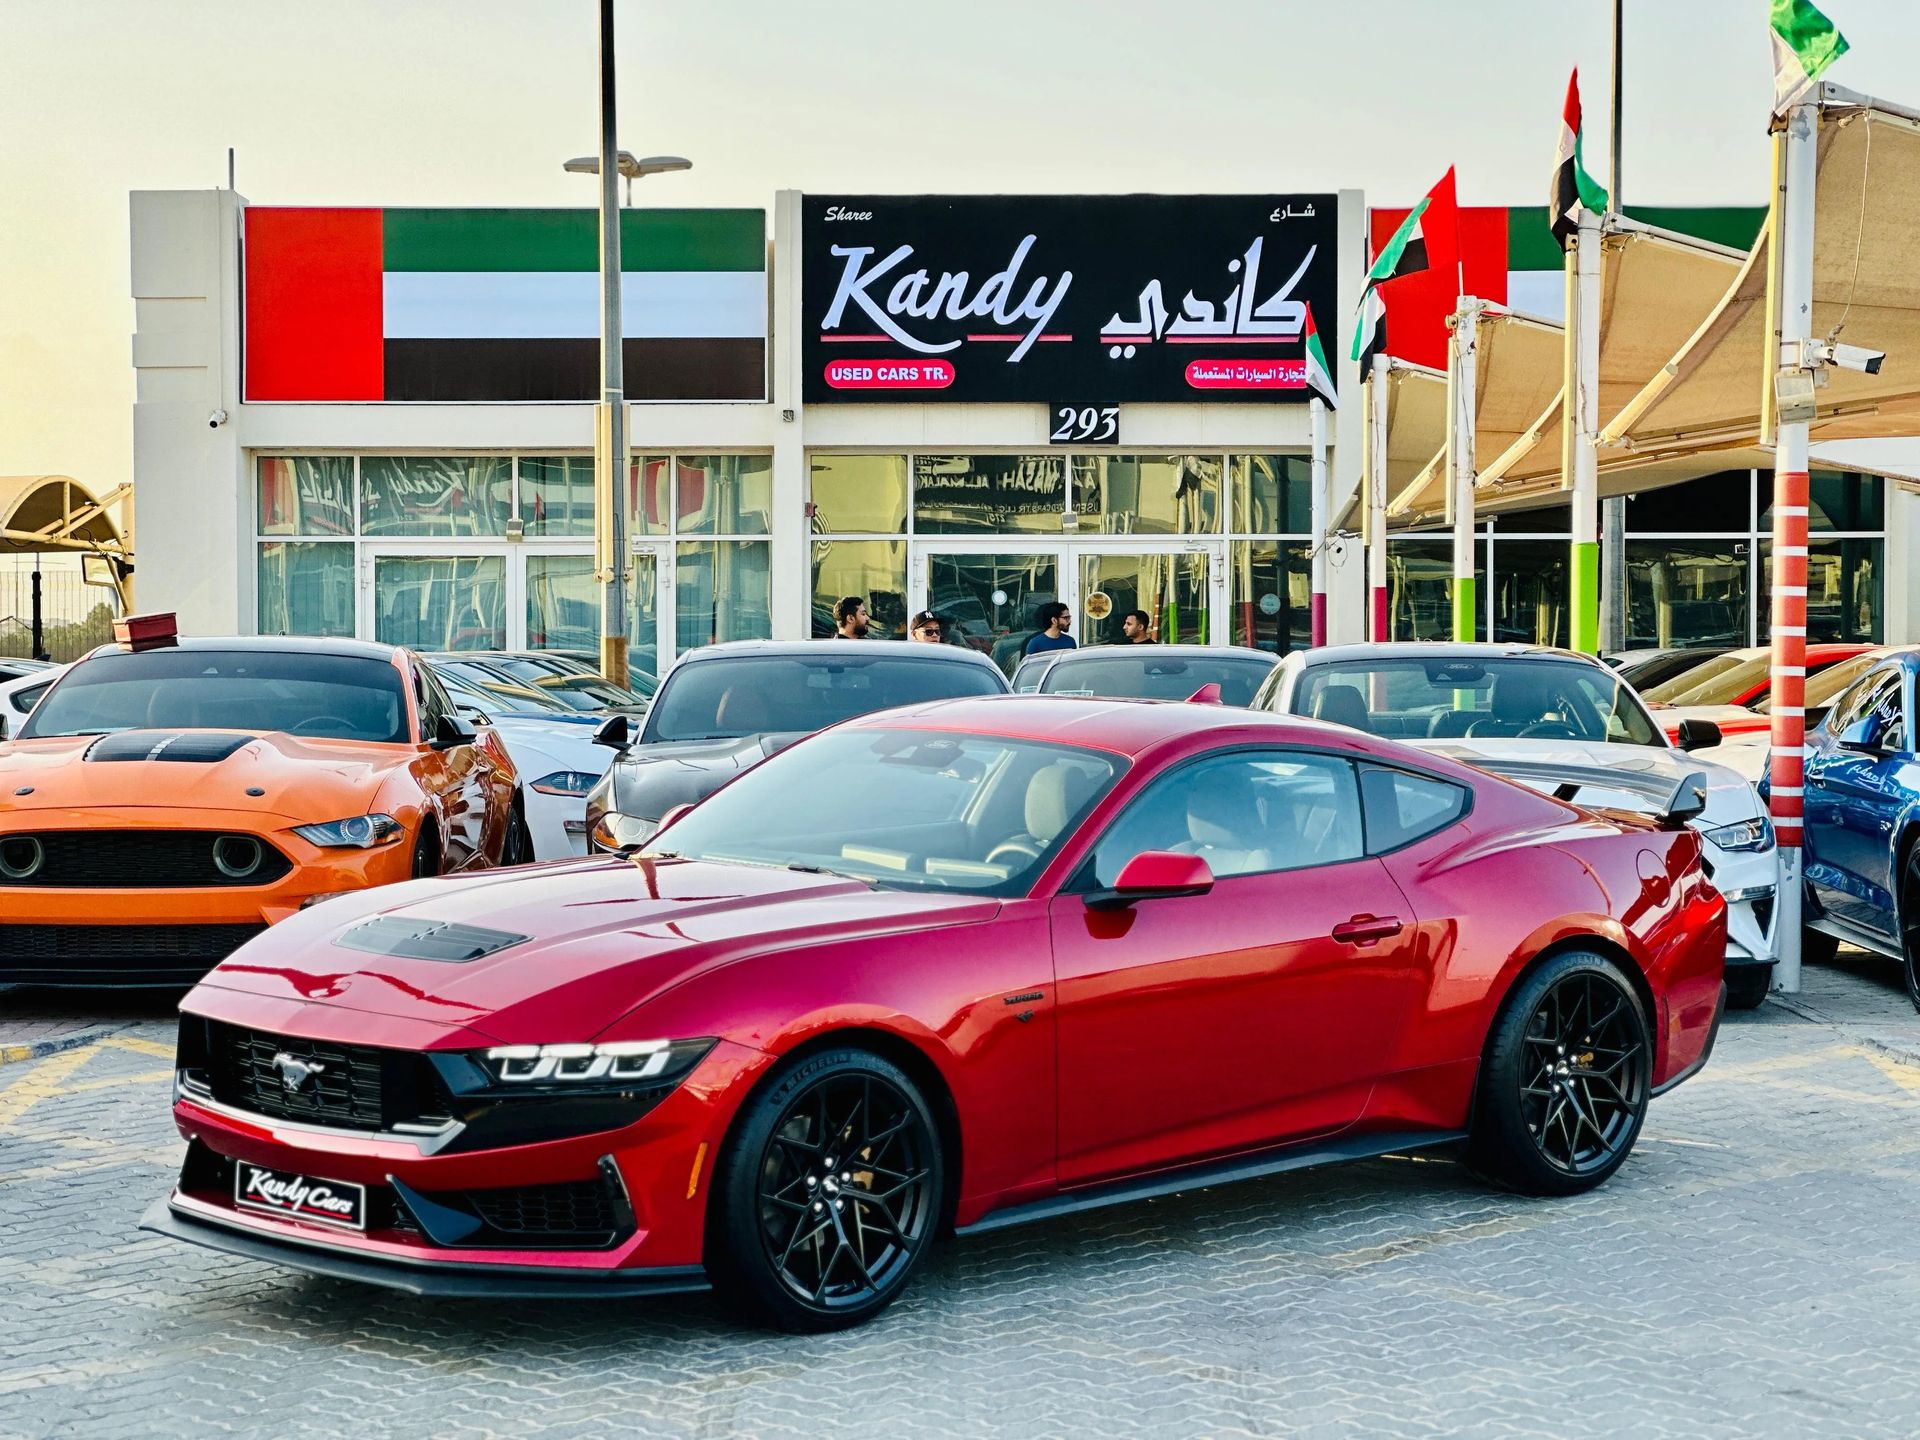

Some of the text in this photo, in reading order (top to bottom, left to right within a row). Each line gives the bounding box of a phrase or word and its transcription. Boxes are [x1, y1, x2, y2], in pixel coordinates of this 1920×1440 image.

[824, 206, 873, 221] Sharee
[1269, 203, 1316, 222] شارع
[821, 234, 1073, 363] Kandy
[1100, 236, 1318, 360] كاندي
[831, 367, 948, 381] USED CARS TR.
[1193, 366, 1234, 380] المستعملة
[1236, 366, 1276, 382] السيارات
[1050, 407, 1120, 441] 293
[785, 1054, 847, 1089] MICHELIN
[247, 1168, 353, 1213] Kandy Cars
